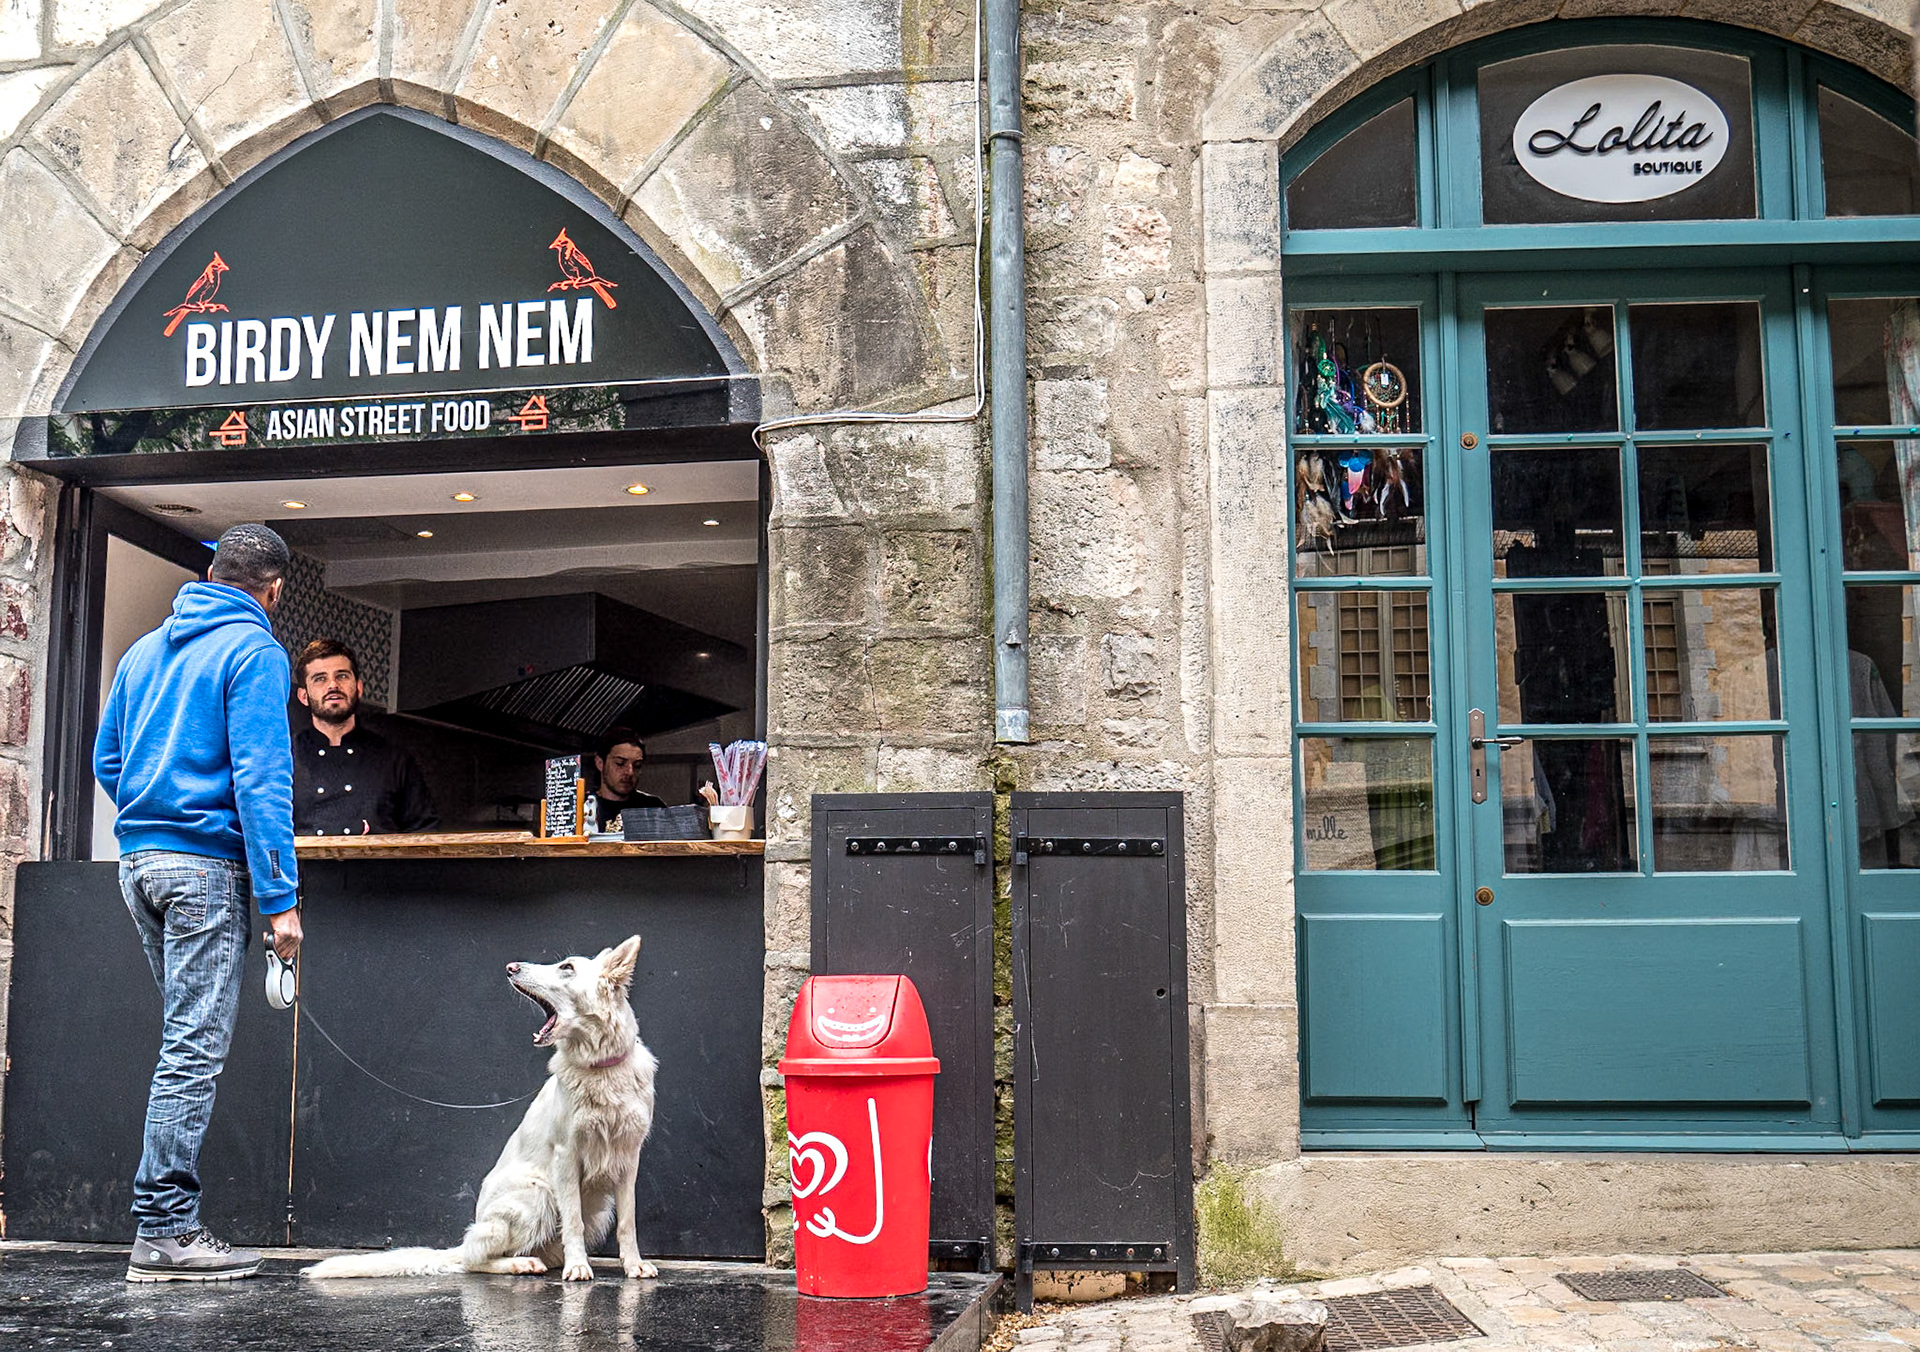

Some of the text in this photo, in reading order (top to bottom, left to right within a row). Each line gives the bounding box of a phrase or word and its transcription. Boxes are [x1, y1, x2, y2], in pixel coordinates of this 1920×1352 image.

[1528, 100, 1714, 154] Lolita
[1633, 160, 1703, 175] BOUTIQUE
[185, 296, 594, 388] BIRDY NEM NEM
[266, 399, 491, 441] ASIAN STREET FOOD
